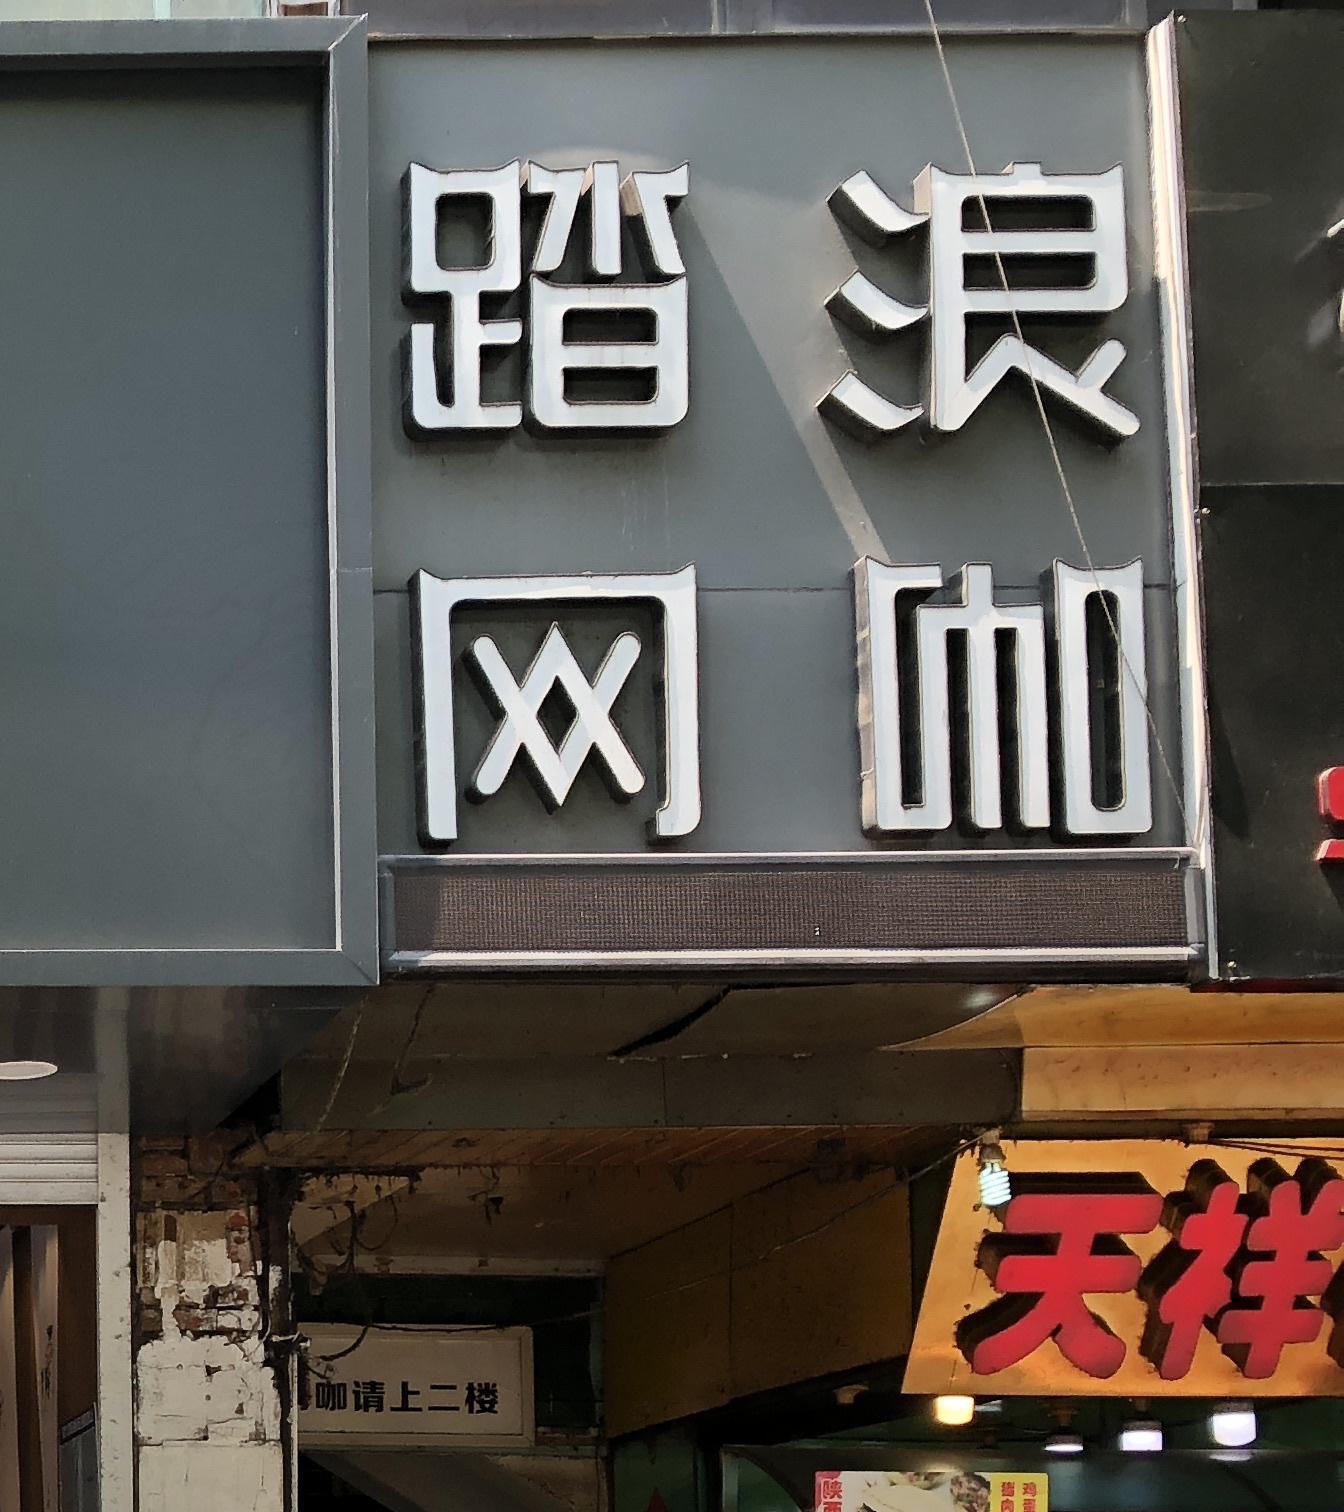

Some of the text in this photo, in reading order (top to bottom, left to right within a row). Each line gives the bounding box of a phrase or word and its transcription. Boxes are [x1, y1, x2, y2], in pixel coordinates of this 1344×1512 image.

[405, 160, 1142, 437] 踏浪
[410, 558, 1153, 842] 网咖
[298, 1380, 499, 1415] 咖请上二楼
[972, 1179, 1344, 1381] 天祥
